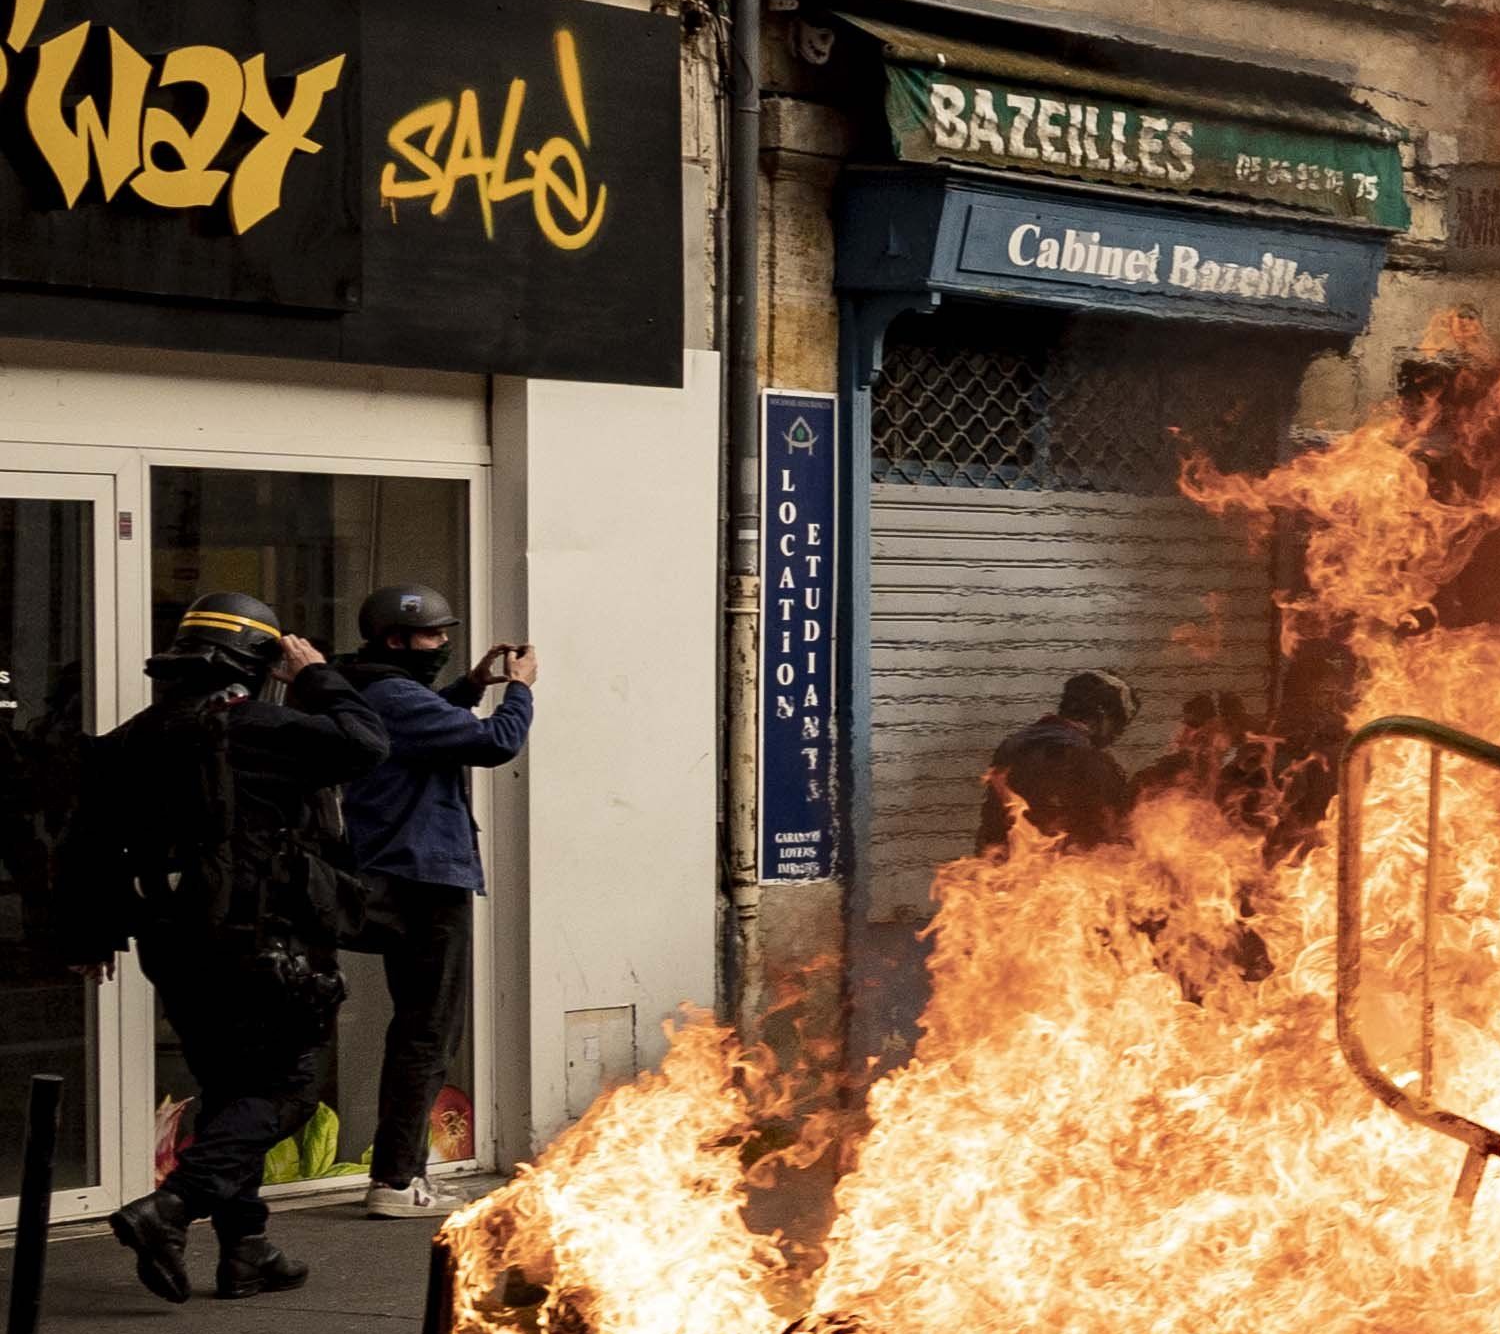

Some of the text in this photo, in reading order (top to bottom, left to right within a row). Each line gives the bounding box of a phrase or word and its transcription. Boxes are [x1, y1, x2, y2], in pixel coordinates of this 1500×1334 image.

[931, 82, 1195, 182] BAZEILLES
[1352, 172, 1380, 201] 75
[1007, 222, 1328, 303] Cabinet Bazeilles
[776, 469, 798, 719] LOCATION
